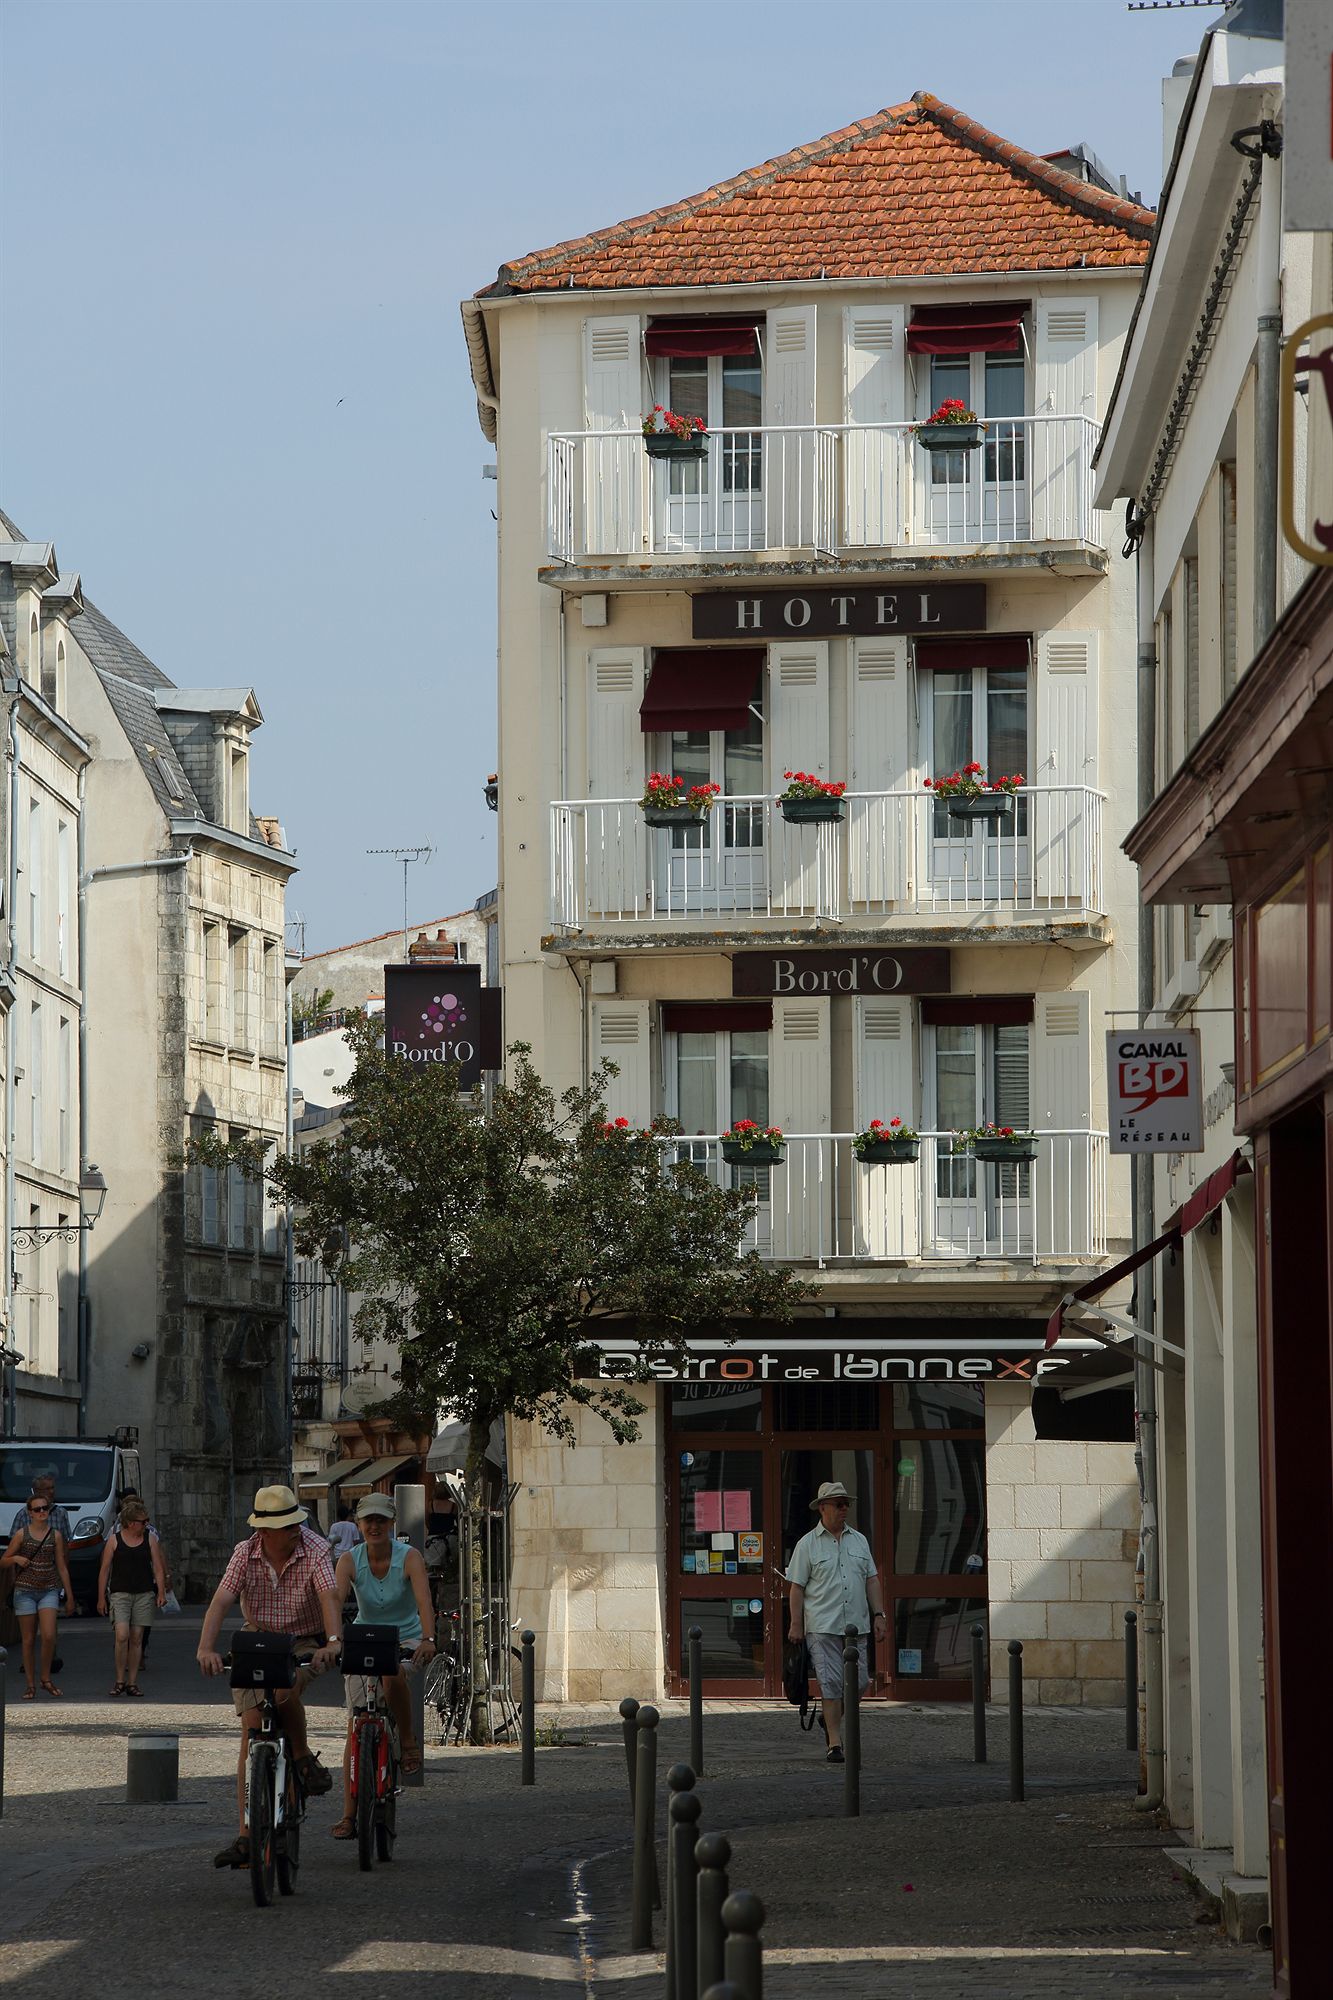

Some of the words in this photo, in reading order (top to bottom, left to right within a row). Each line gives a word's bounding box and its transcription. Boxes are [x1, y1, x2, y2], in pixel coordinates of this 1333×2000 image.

[735, 594, 940, 629] HOTEL
[1118, 1042, 1187, 1058] CANAL
[1124, 1061, 1184, 1093] BD
[1120, 1119, 1135, 1128] LE
[1120, 1131, 1190, 1142] RÉSEAU
[784, 1366, 820, 1379] de
